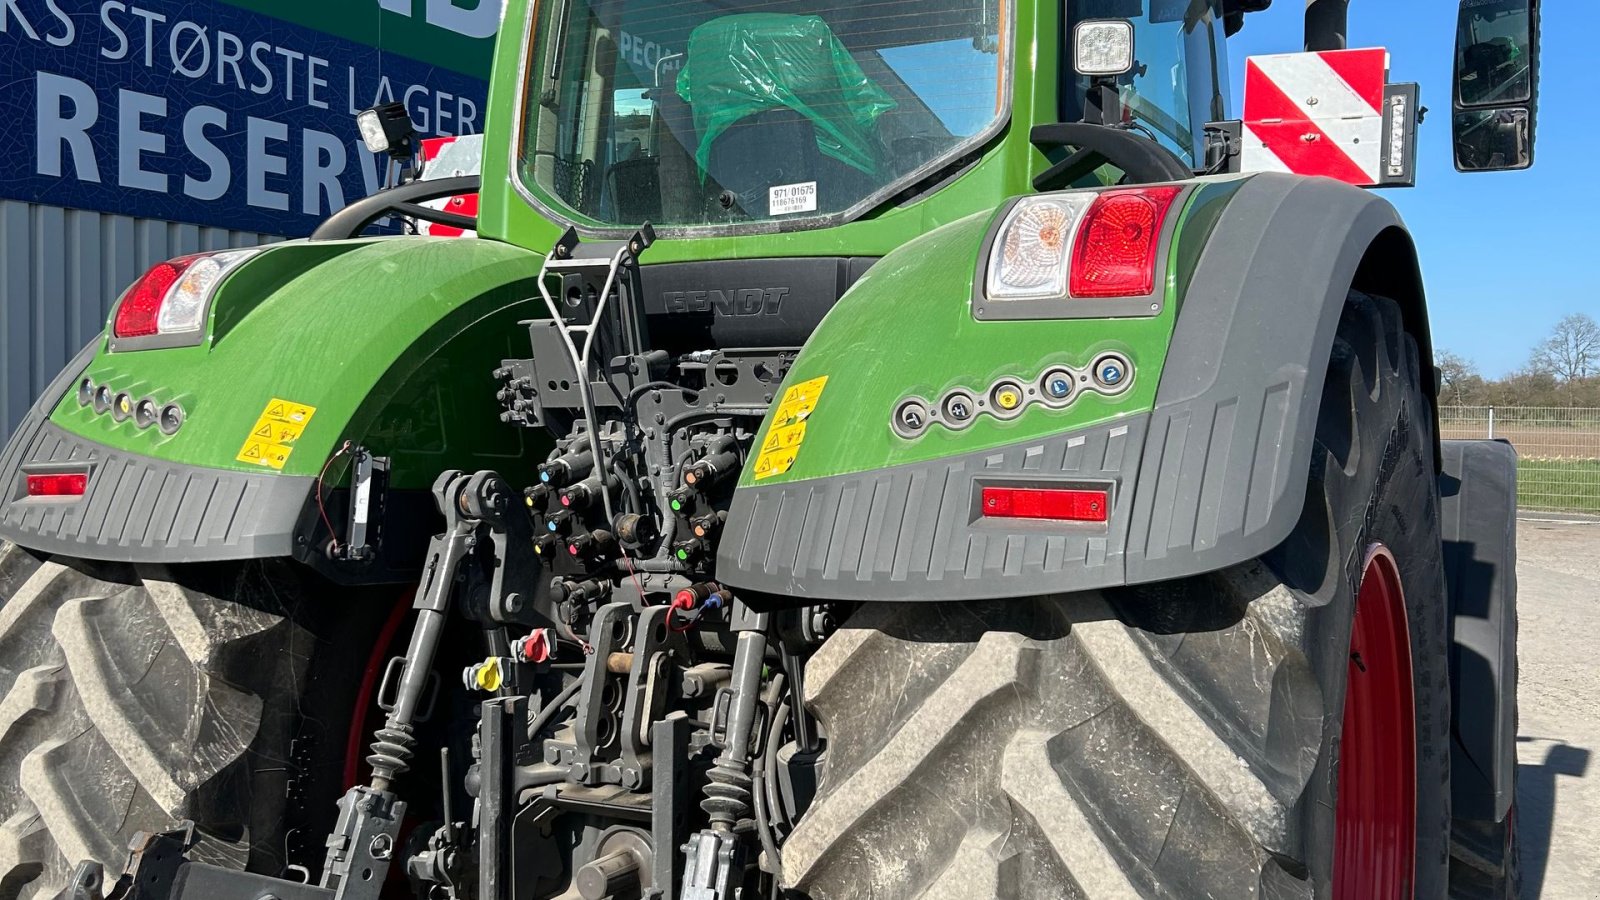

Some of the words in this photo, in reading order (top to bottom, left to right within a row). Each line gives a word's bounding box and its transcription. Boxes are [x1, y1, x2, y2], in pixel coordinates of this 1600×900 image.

[100, 0, 330, 110] STØRSTE
[349, 65, 477, 136] LAGER
[36, 70, 418, 227] RESERV
[663, 287, 790, 317] FENDT
